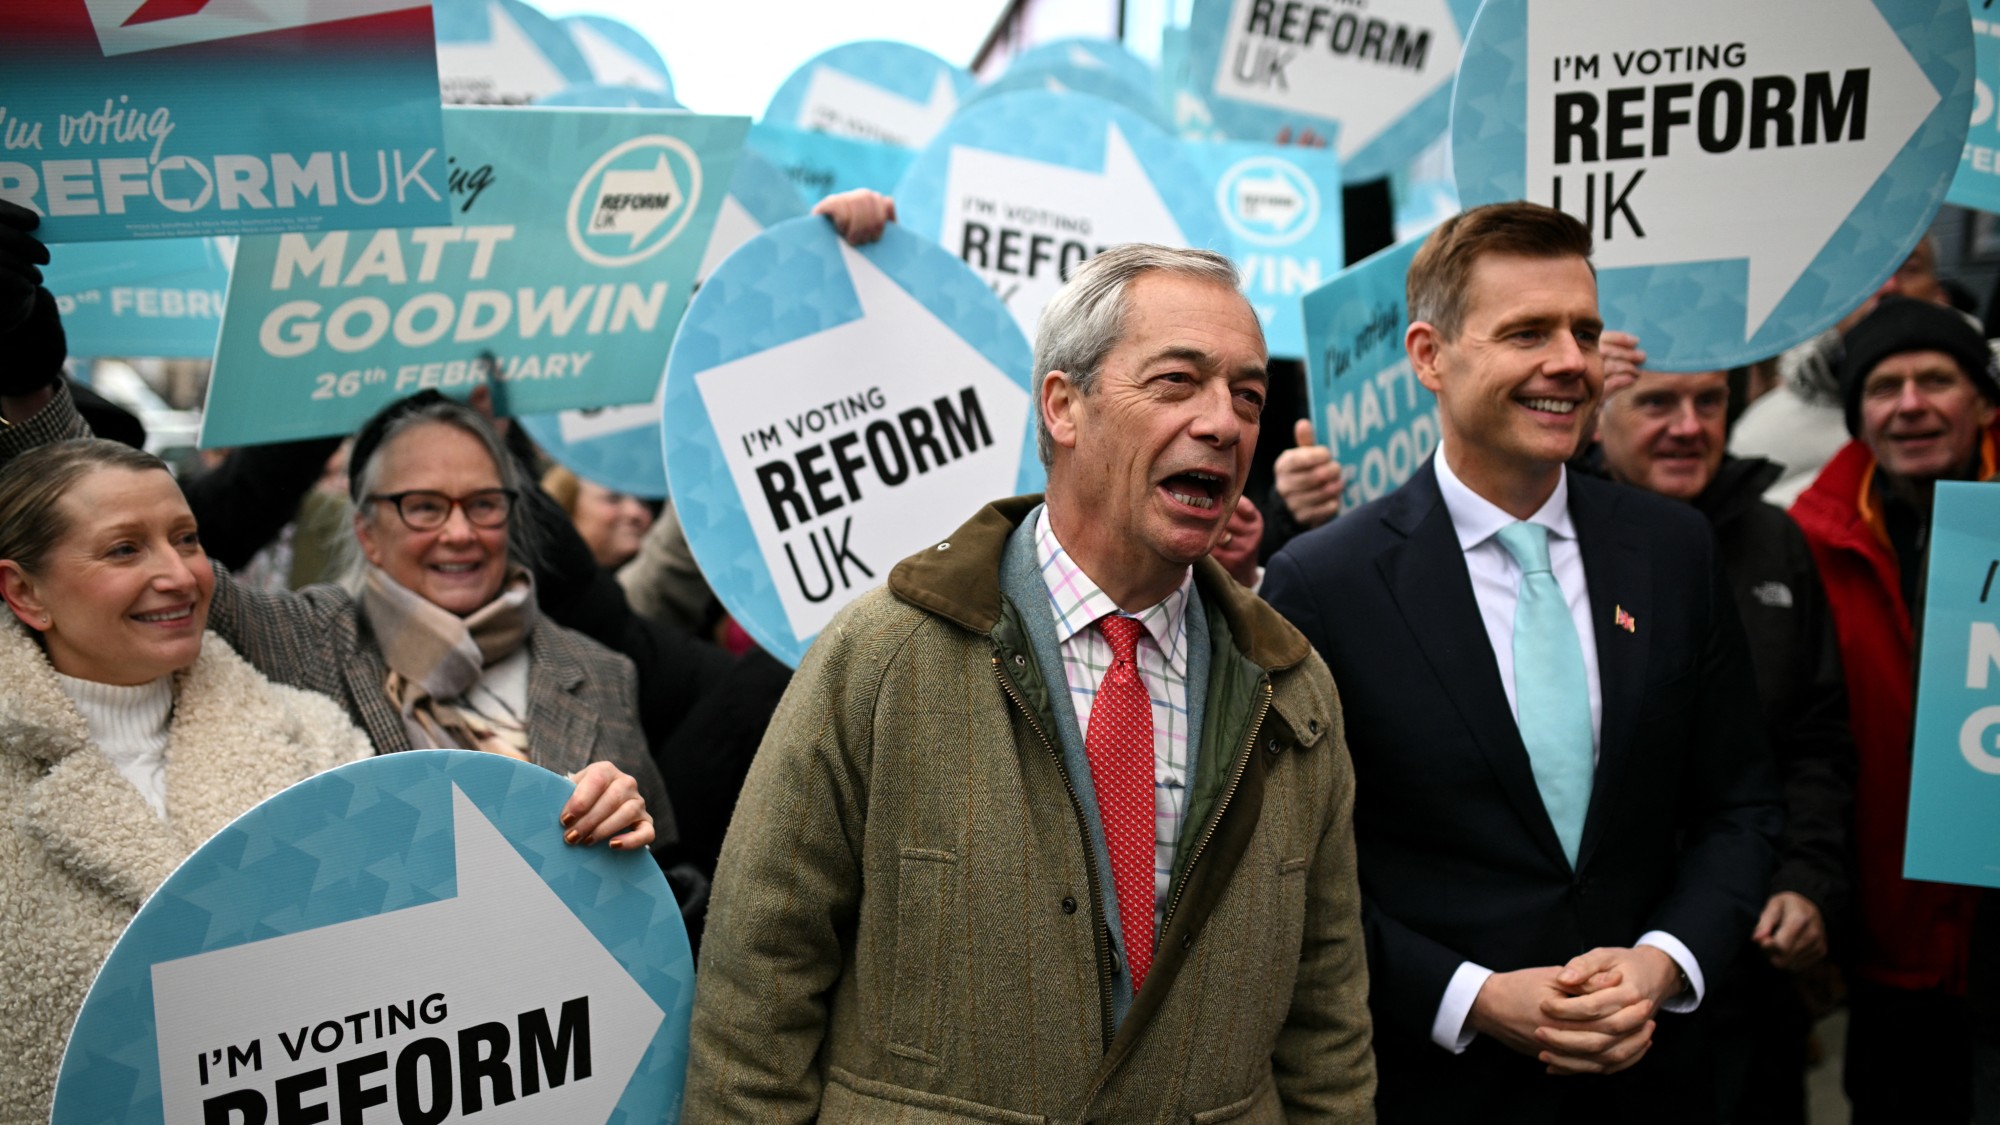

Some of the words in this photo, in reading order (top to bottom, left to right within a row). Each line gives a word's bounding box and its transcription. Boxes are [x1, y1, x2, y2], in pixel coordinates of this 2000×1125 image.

[1231, 36, 1297, 96] UK
[1246, 0, 1433, 75] REFORM
[1554, 53, 1600, 82] I'M
[1613, 42, 1747, 77] VOTING
[59, 95, 176, 165] voting
[1553, 66, 1871, 165] REFORM
[600, 192, 671, 211] REFORM
[1003, 202, 1092, 235] VOTING
[1552, 168, 1647, 241] UK
[270, 224, 516, 291] MATT
[962, 219, 1108, 285] REFO
[258, 281, 668, 359] GOODWIN
[311, 368, 387, 400] 26th
[394, 351, 593, 392] FEBRUARY
[741, 424, 783, 457] I'M
[786, 386, 886, 439] VOTING
[755, 385, 994, 533] REFORM
[1338, 405, 1442, 516] GOOD
[784, 516, 875, 603] UK
[198, 1039, 263, 1086] I'M
[278, 993, 448, 1062] VOTING
